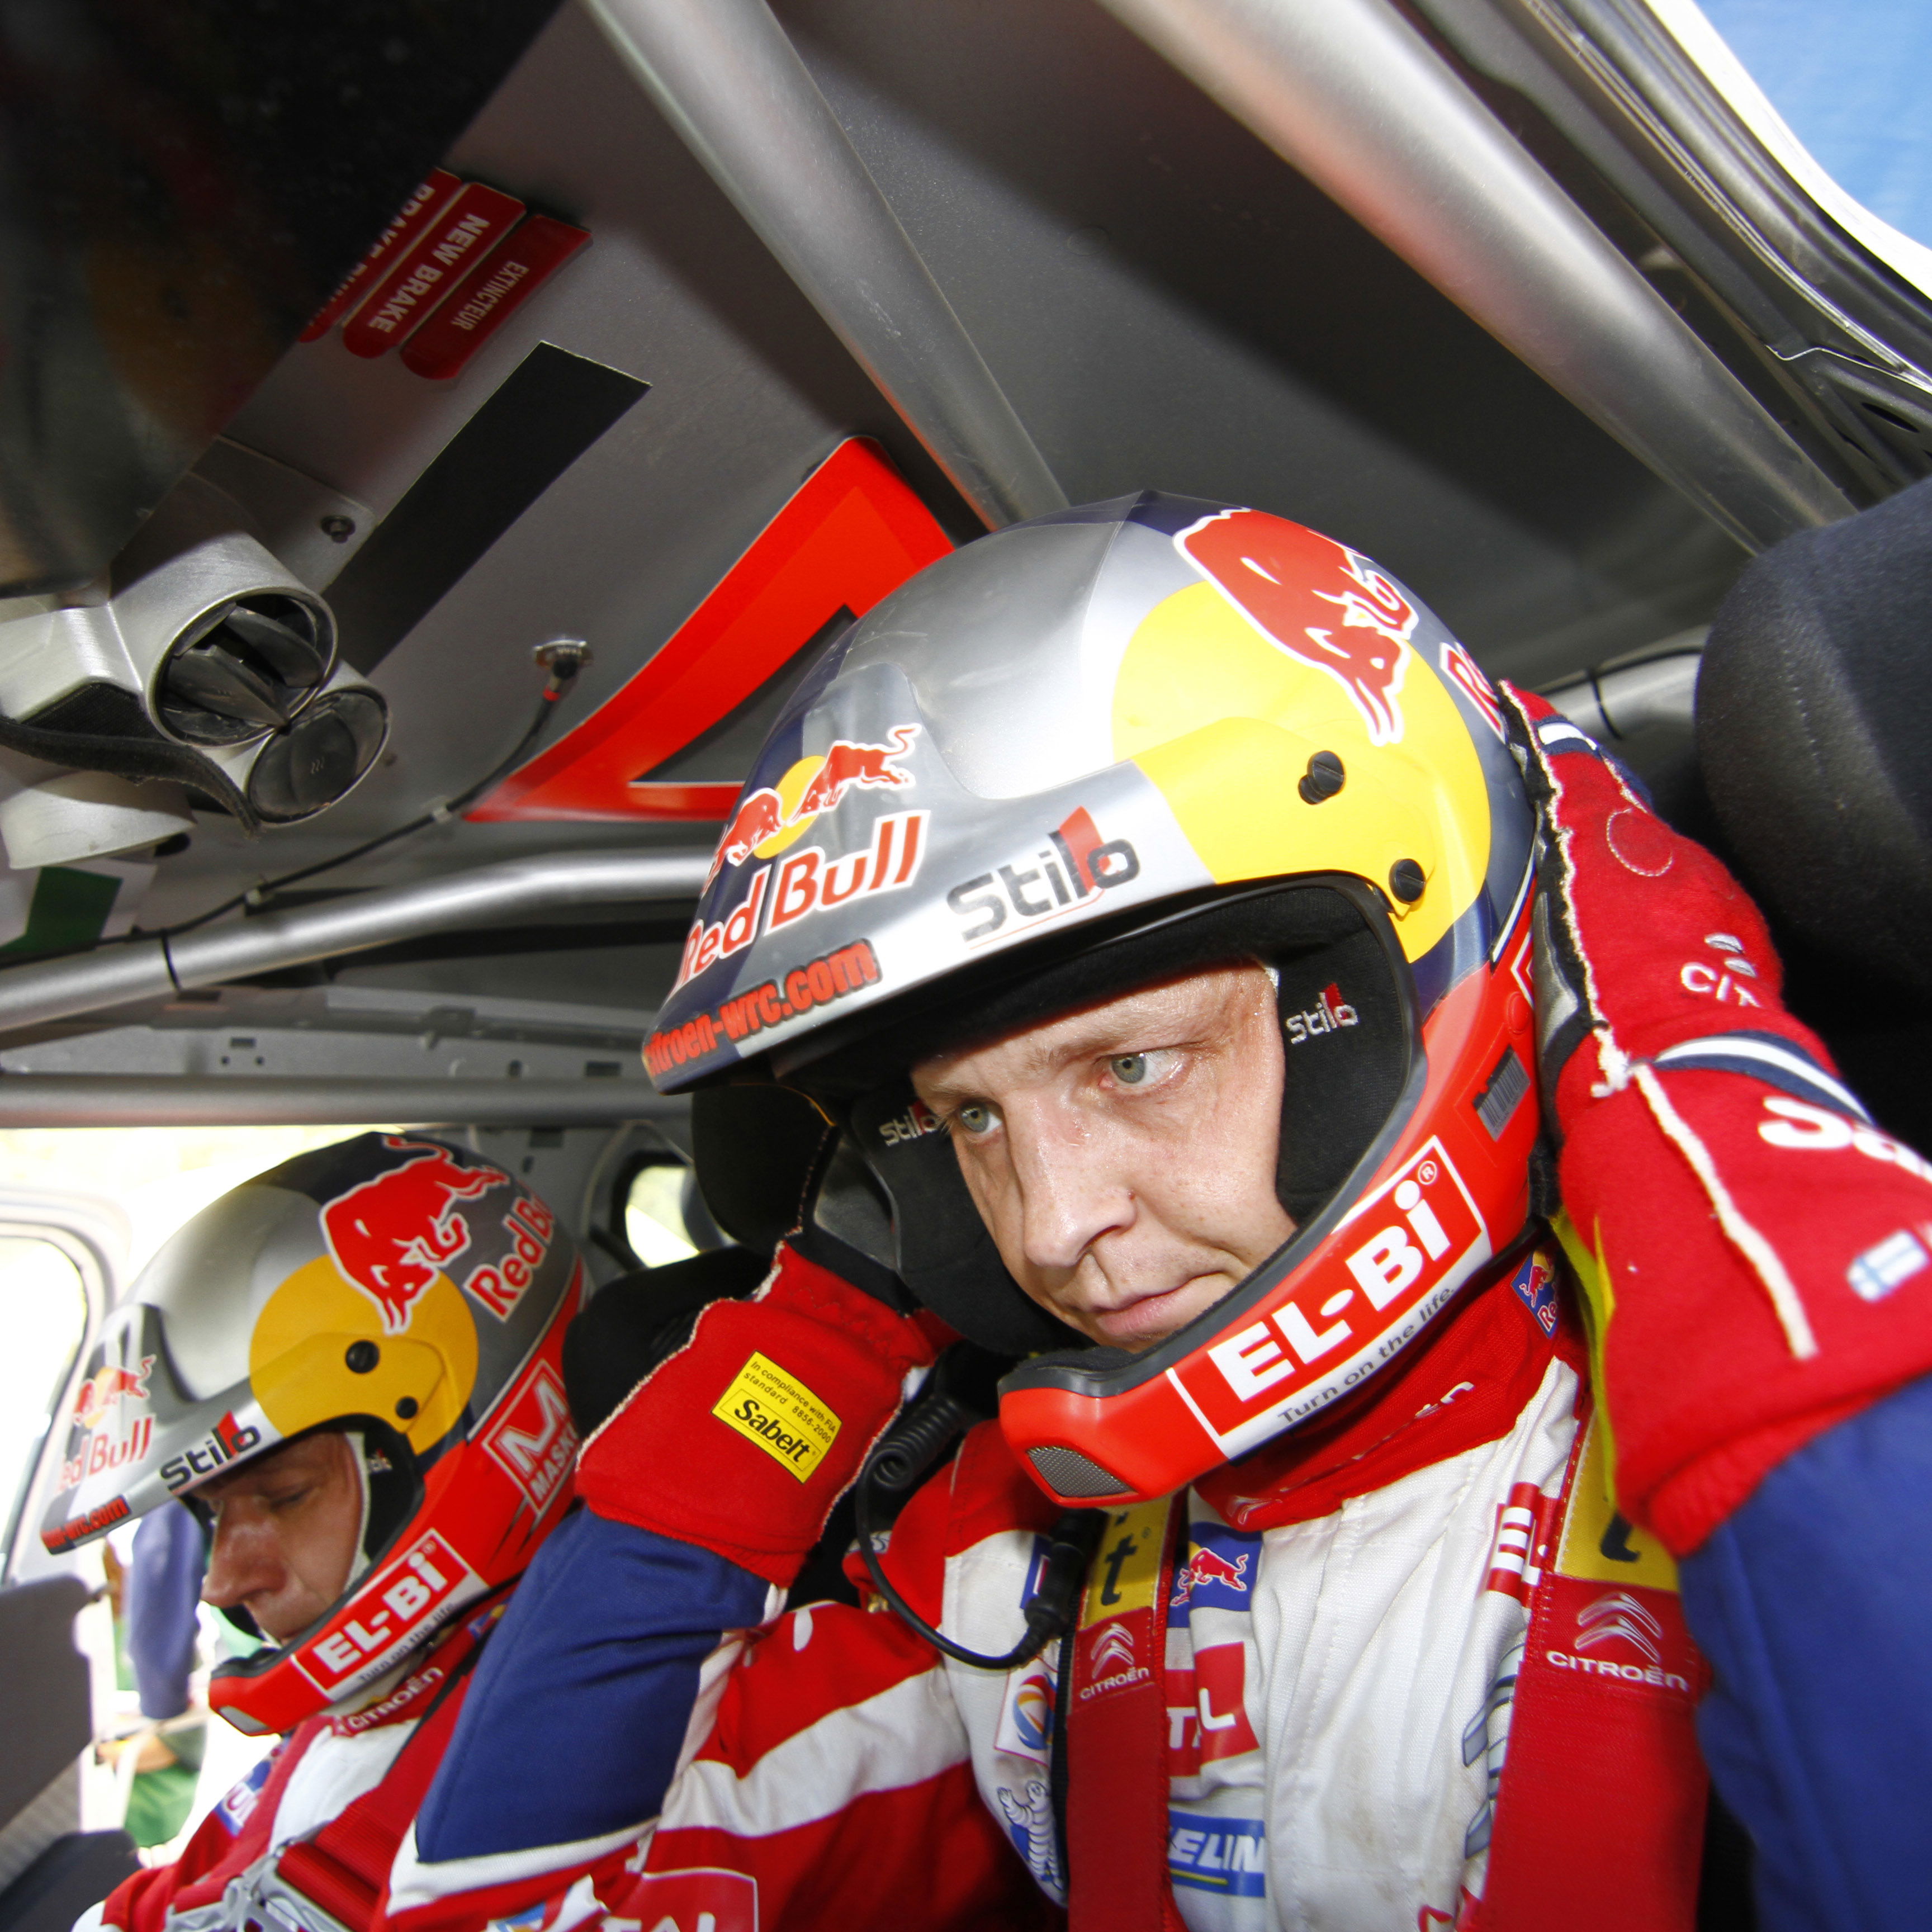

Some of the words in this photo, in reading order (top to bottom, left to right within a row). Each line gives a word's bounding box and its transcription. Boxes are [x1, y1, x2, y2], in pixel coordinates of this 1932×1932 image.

[432, 213, 490, 266] NEW
[367, 264, 444, 333] BRAKE
[451, 261, 529, 330] EXTINCTEUR
[764, 809, 931, 936] Bull
[465, 1214, 546, 1322] Red
[1538, 1301, 1558, 1332] Re
[744, 1372, 788, 1404] standard
[792, 1406, 831, 1443] 8856-2000
[750, 1361, 761, 1371] In
[761, 1367, 809, 1407] compliance
[809, 1405, 824, 1422] with
[825, 1419, 836, 1433] FIA
[1277, 1386, 1339, 1424] Turn
[1344, 1361, 1374, 1387] on
[1379, 1324, 1414, 1359] the
[88, 1414, 157, 1477] Bull
[734, 1399, 811, 1462] Sabelt
[1171, 1827, 1264, 1873] ELIN
